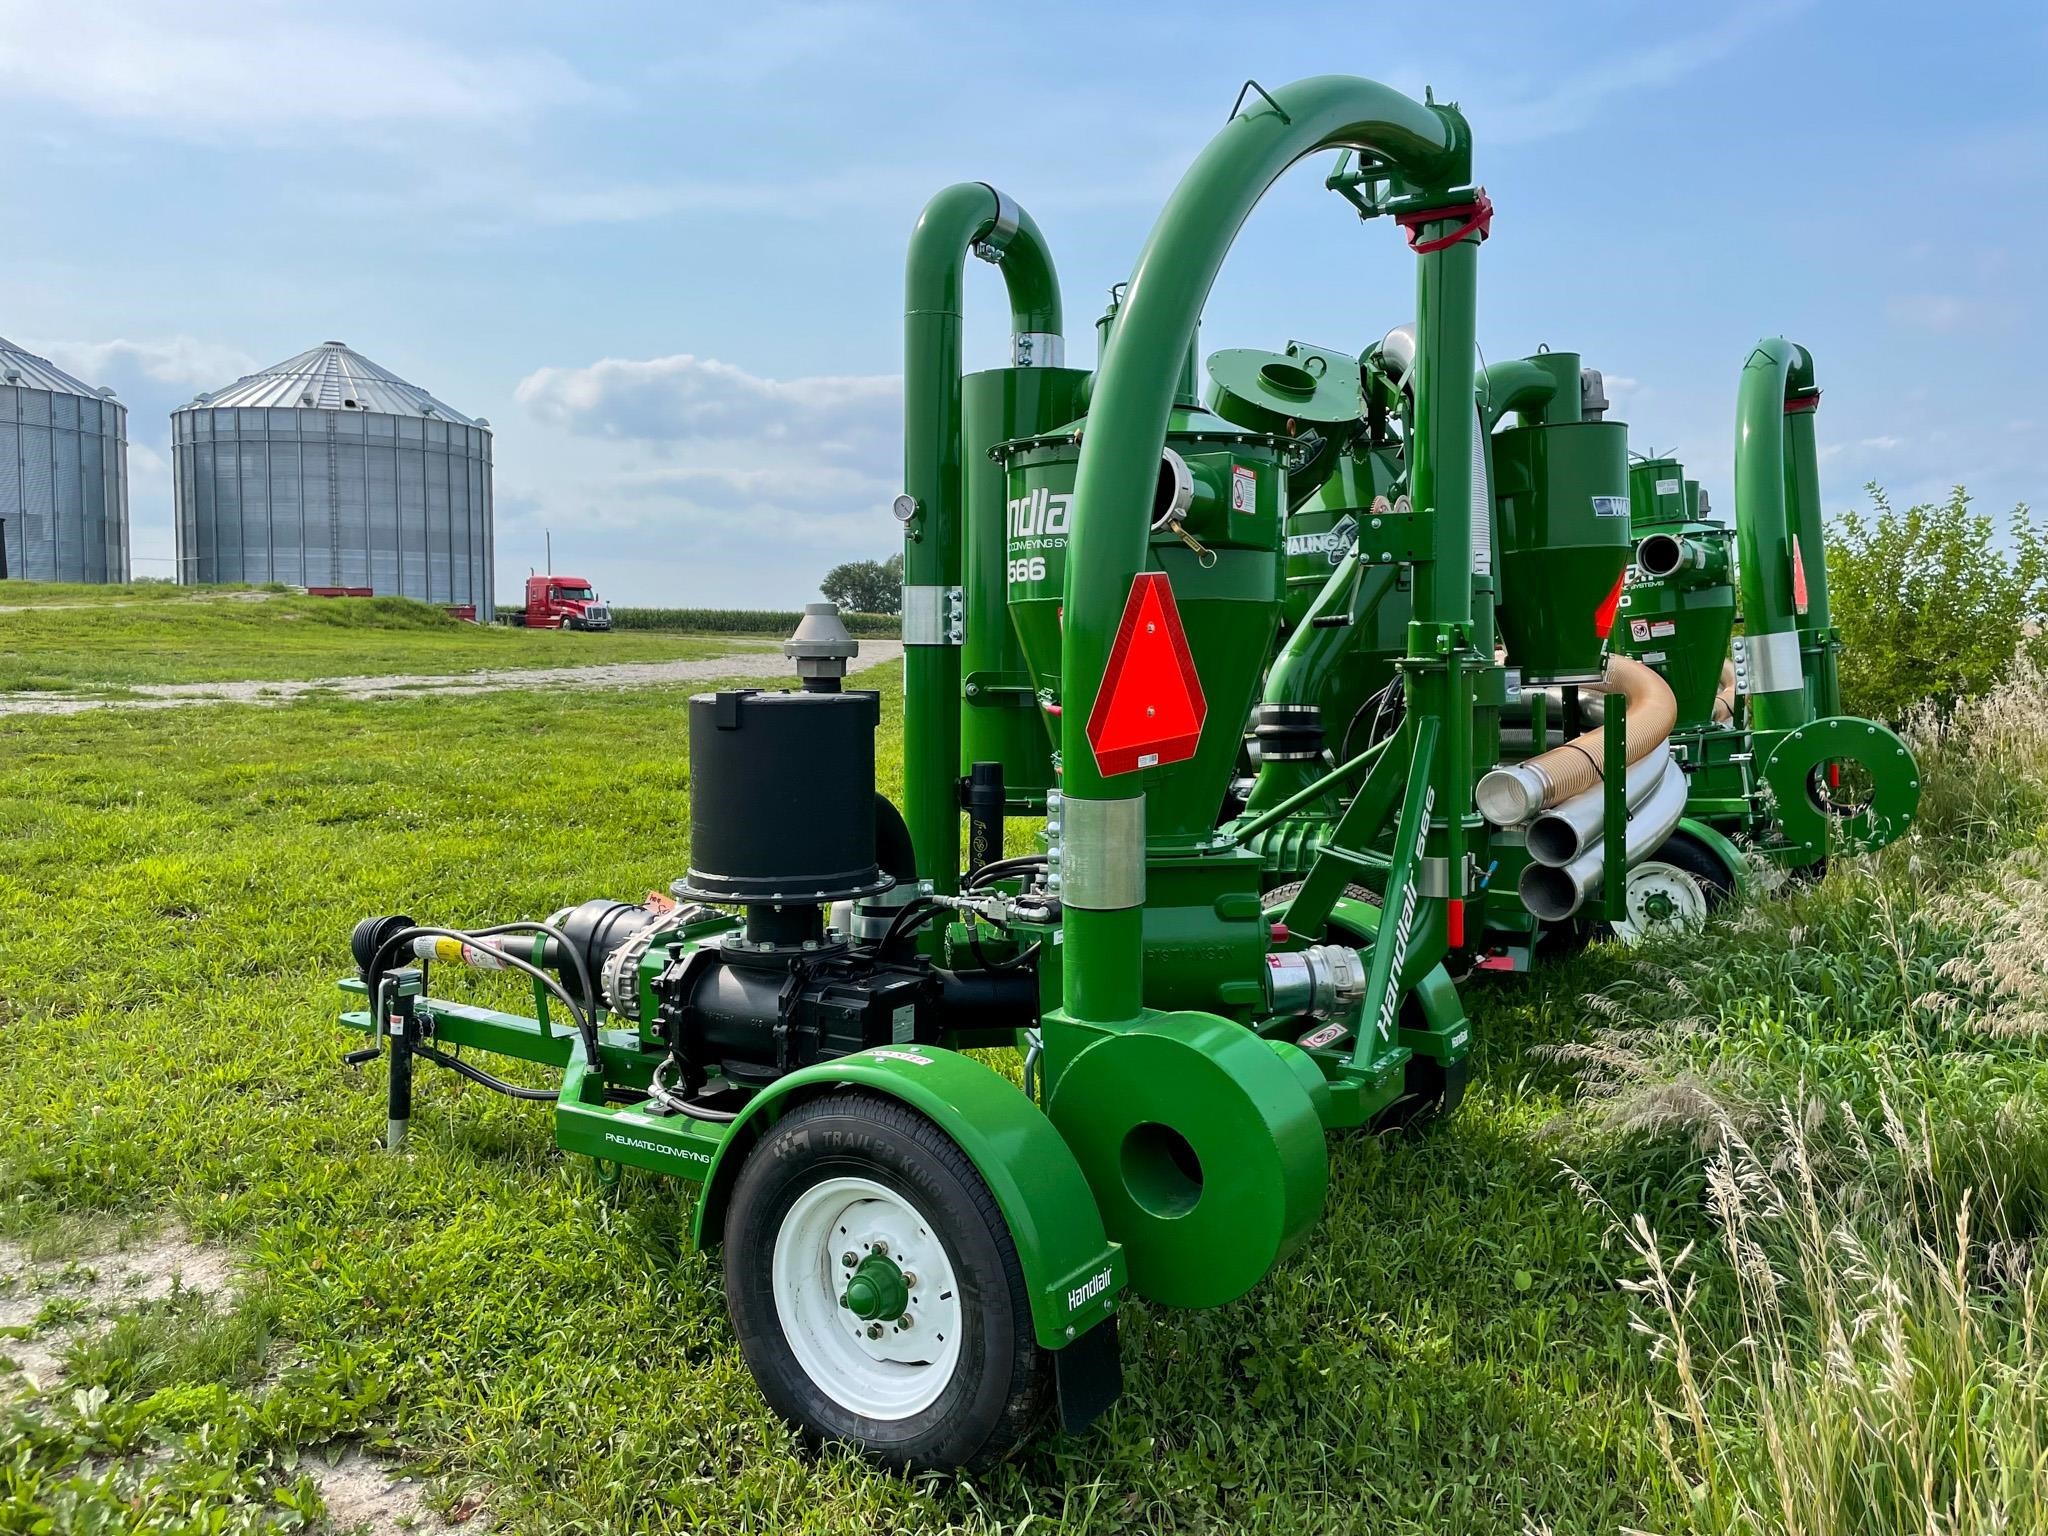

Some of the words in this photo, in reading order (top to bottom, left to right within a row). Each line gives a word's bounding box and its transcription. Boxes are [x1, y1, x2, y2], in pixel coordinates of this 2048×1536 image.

[1008, 488, 1073, 538] ndla
[1377, 869, 1418, 1042] Handlair
[1416, 785, 1436, 861] 566
[605, 1132, 656, 1152] PNEUMATIC
[656, 1144, 710, 1164] CONVEYING
[822, 1131, 896, 1157] TRAILER
[900, 1154, 943, 1197] KING
[1068, 1266, 1112, 1311] Handlair
